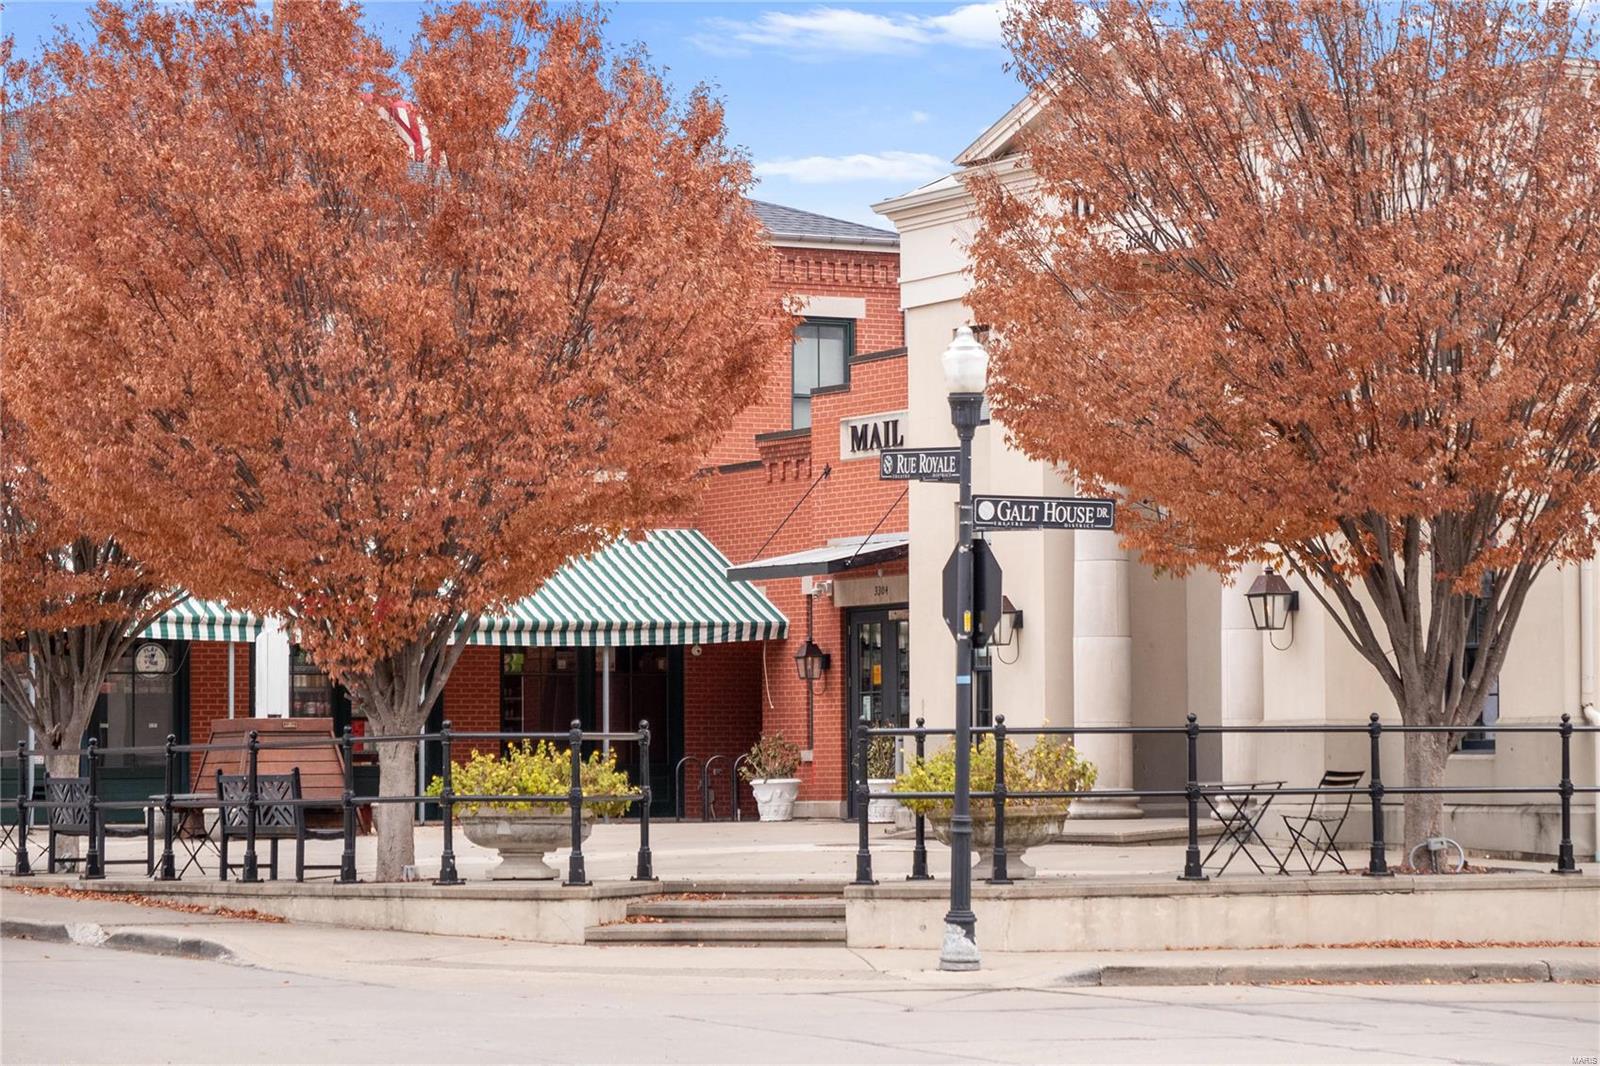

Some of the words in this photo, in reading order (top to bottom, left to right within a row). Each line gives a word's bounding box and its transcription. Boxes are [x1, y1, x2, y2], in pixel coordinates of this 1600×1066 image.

[850, 419, 904, 453] MAIL
[897, 454, 917, 474] RUE
[918, 453, 956, 474] ROYALE
[997, 500, 1039, 522] GALT
[1043, 502, 1095, 523] HOUSE
